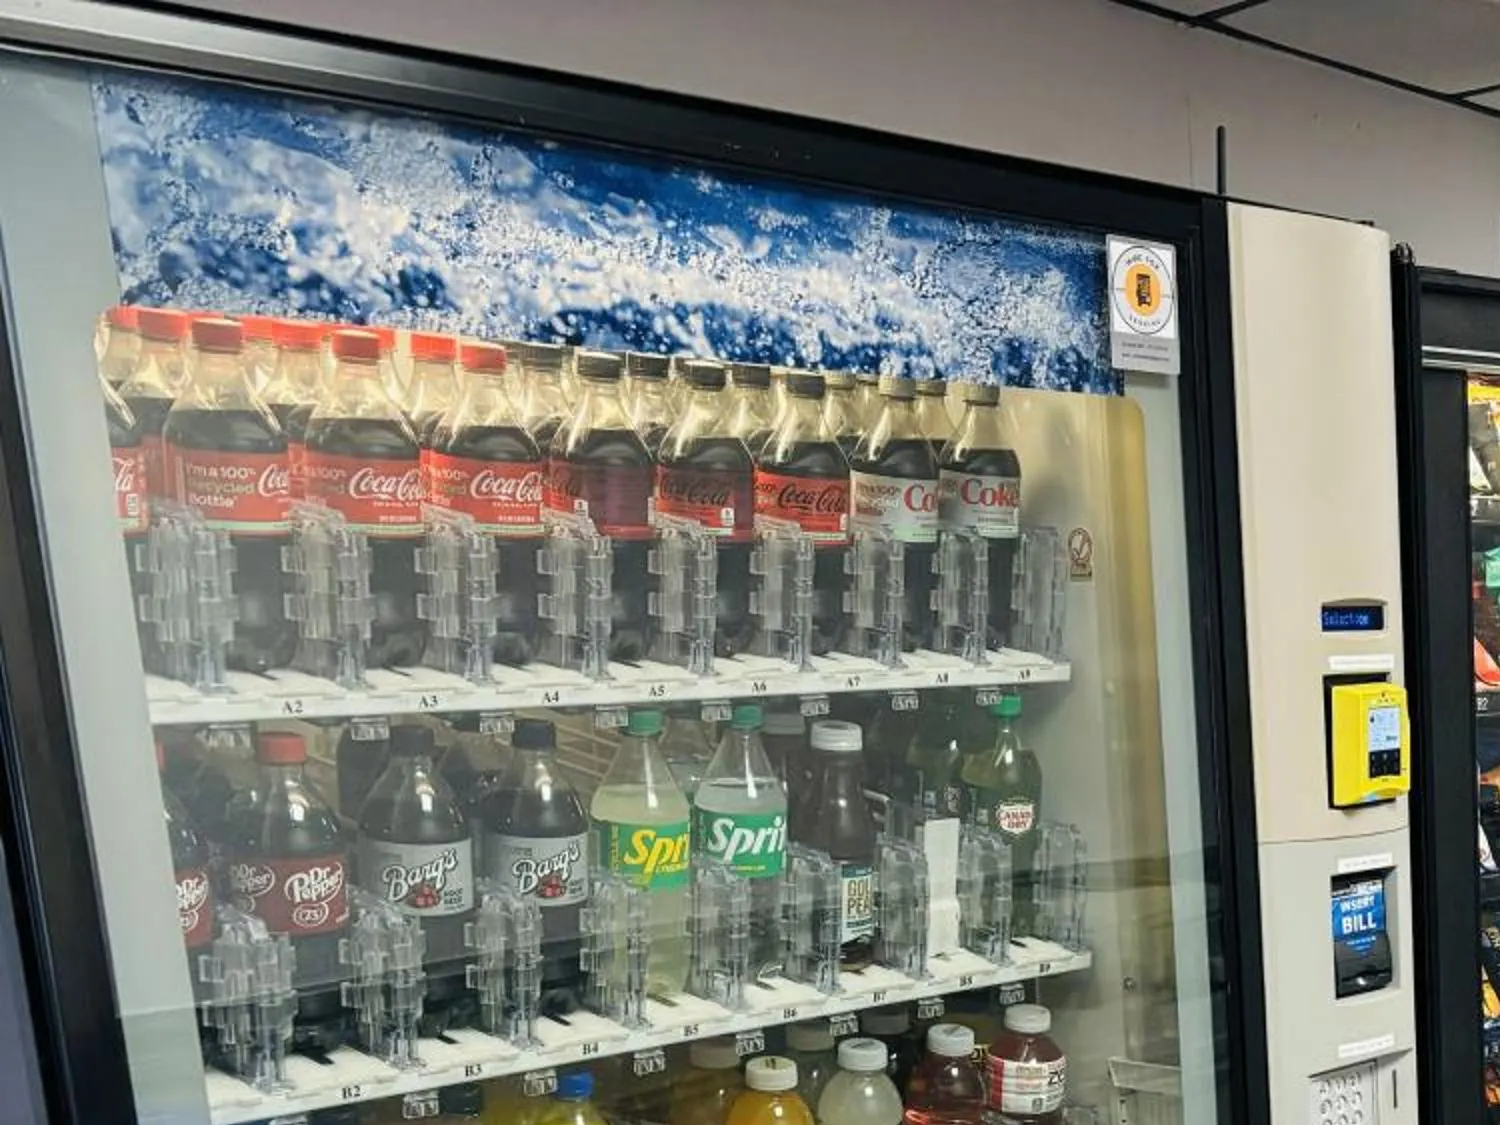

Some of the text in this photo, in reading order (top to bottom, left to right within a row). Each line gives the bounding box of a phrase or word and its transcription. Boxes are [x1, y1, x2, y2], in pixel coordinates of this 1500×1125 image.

[961, 478, 1020, 508] Coke
[751, 680, 767, 693] A6
[845, 675, 860, 688] A7
[541, 691, 559, 705] A4
[649, 685, 665, 698] A5
[282, 701, 303, 714] A2
[417, 695, 438, 709] A3
[512, 840, 580, 894] Barq's
[309, 867, 331, 882] Dr
[383, 848, 457, 902] Barq's
[287, 870, 343, 904] Pepper
[1340, 895, 1376, 912] INSERT
[1342, 911, 1376, 934] BILL
[582, 1043, 598, 1055] B4
[464, 1065, 483, 1077] B3
[342, 1086, 361, 1099] B2
